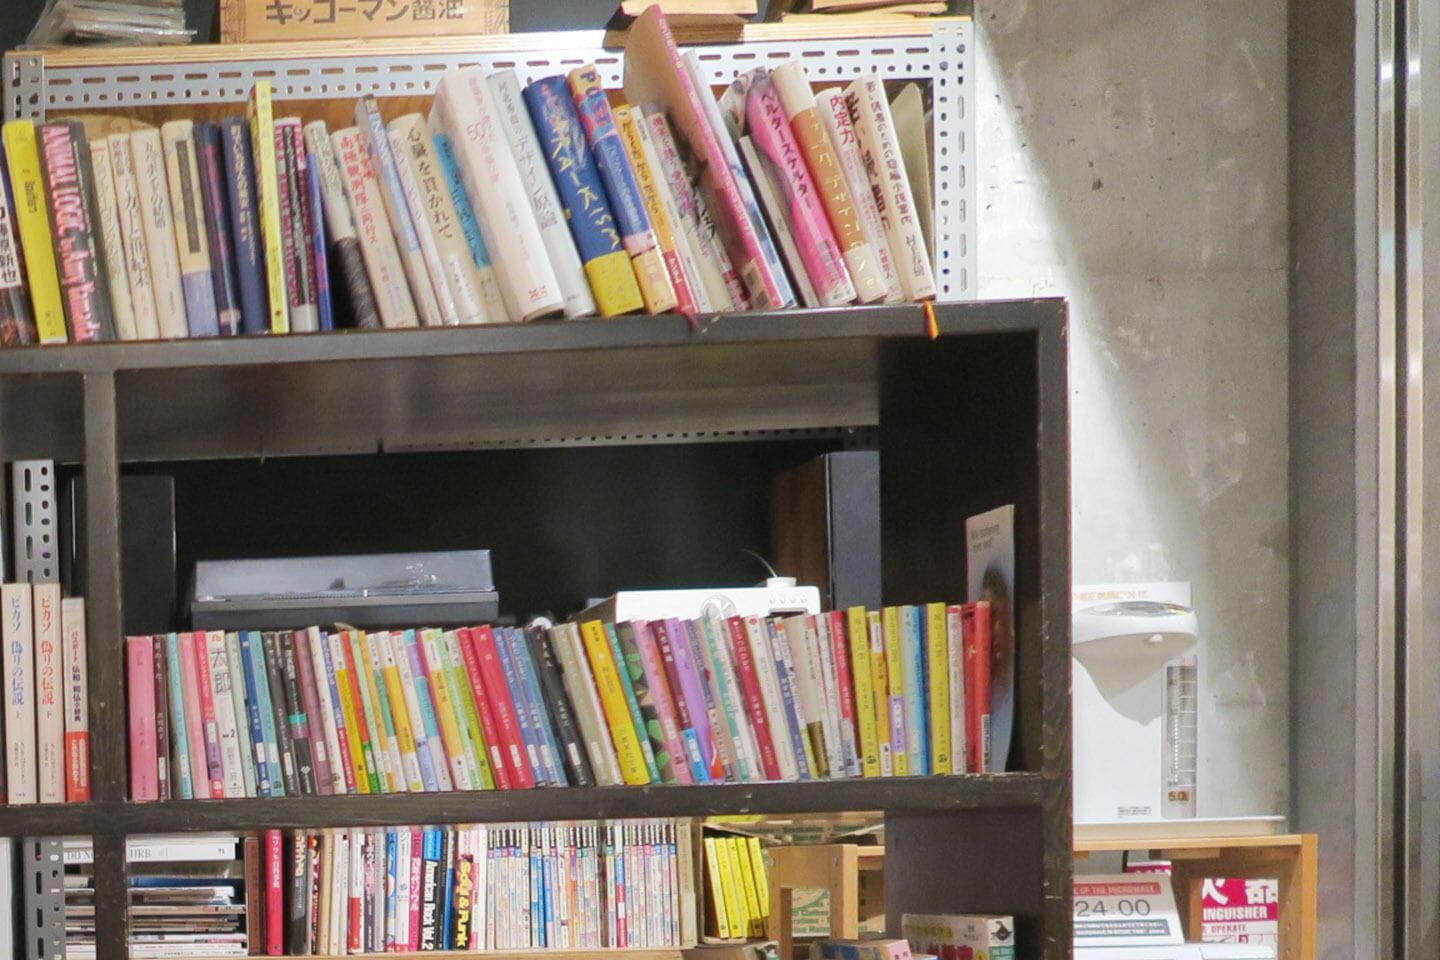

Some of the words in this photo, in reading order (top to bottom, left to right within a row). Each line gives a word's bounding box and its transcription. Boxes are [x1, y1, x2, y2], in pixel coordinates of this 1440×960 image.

[266, 0, 464, 24] キッコーマン醤油
[829, 94, 855, 145] 内定力
[760, 91, 811, 211] ヘルタースケルター
[407, 127, 453, 240] 心臓を貫かれて
[10, 597, 22, 633] ピカソ
[41, 597, 53, 633] ピカソ
[10, 641, 24, 706] 偽りの伝説
[41, 641, 54, 706] 偽りの伝説
[423, 860, 437, 901] American
